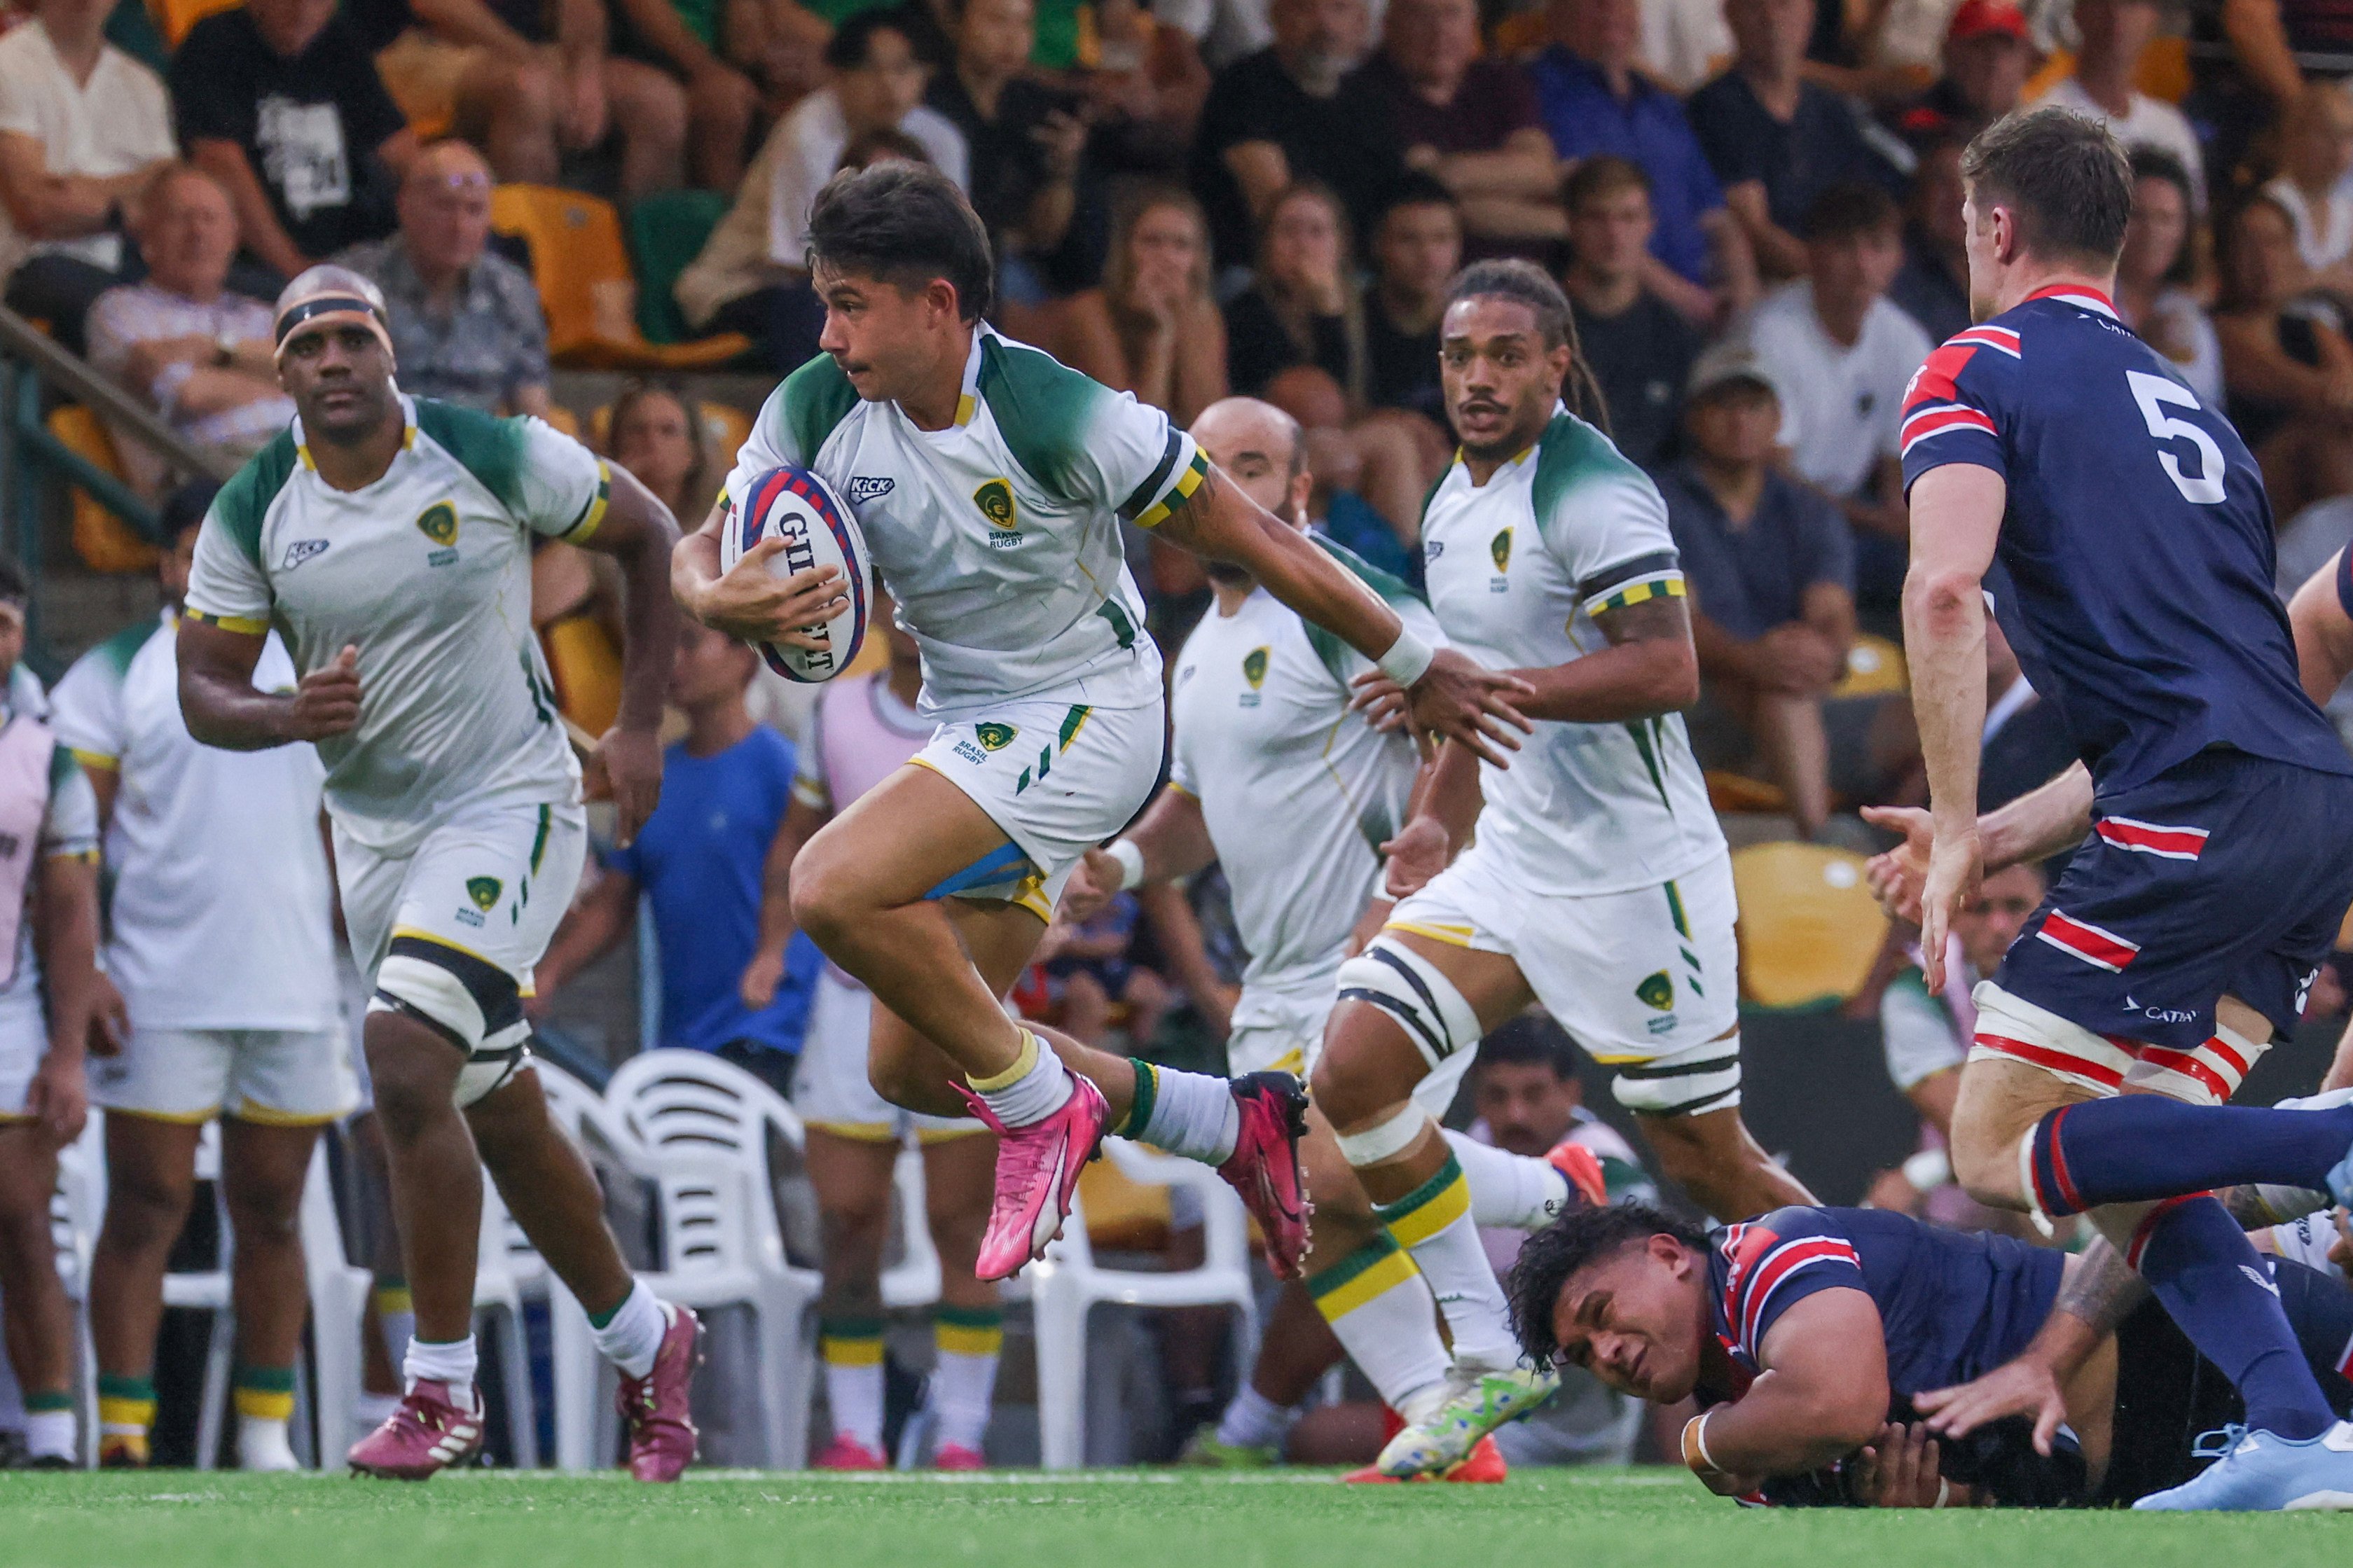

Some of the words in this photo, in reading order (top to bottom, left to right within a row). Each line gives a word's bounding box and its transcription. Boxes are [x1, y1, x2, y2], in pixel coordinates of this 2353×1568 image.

[2125, 370, 2227, 504] 5
[990, 537, 1022, 548] RUGBY
[952, 746, 983, 765] RUGBY
[958, 740, 988, 762] BRASIL
